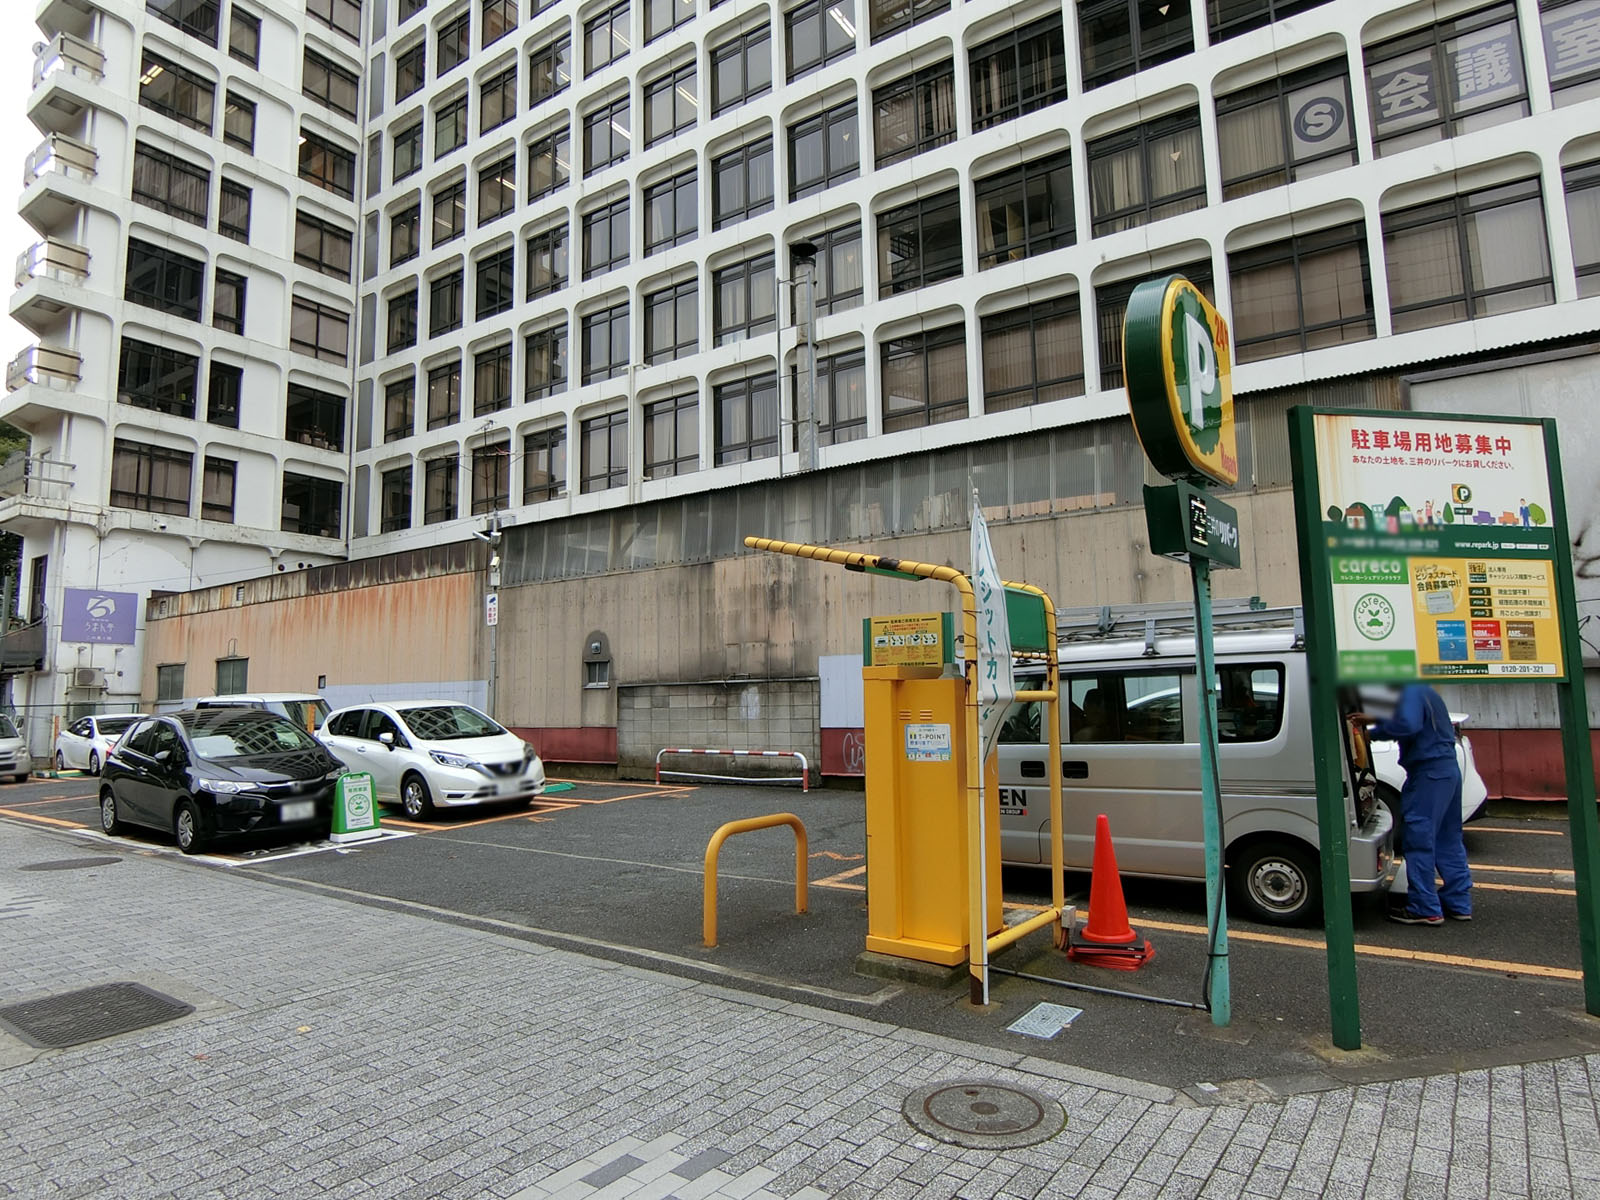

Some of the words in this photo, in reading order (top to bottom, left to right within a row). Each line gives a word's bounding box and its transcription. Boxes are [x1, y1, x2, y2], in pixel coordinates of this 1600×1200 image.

[1185, 312, 1216, 432] P
[1351, 429, 1512, 456] 駐車場用地募集中
[1352, 456, 1515, 471] あなたの土地を、三井のリパークにお貸しください。
[1454, 540, 1499, 550] www.repark.jp
[1338, 559, 1401, 574] careco
[1416, 570, 1457, 581] ビジネスカード
[1358, 597, 1390, 614] careco
[1501, 666, 1544, 674] 0120-201-321
